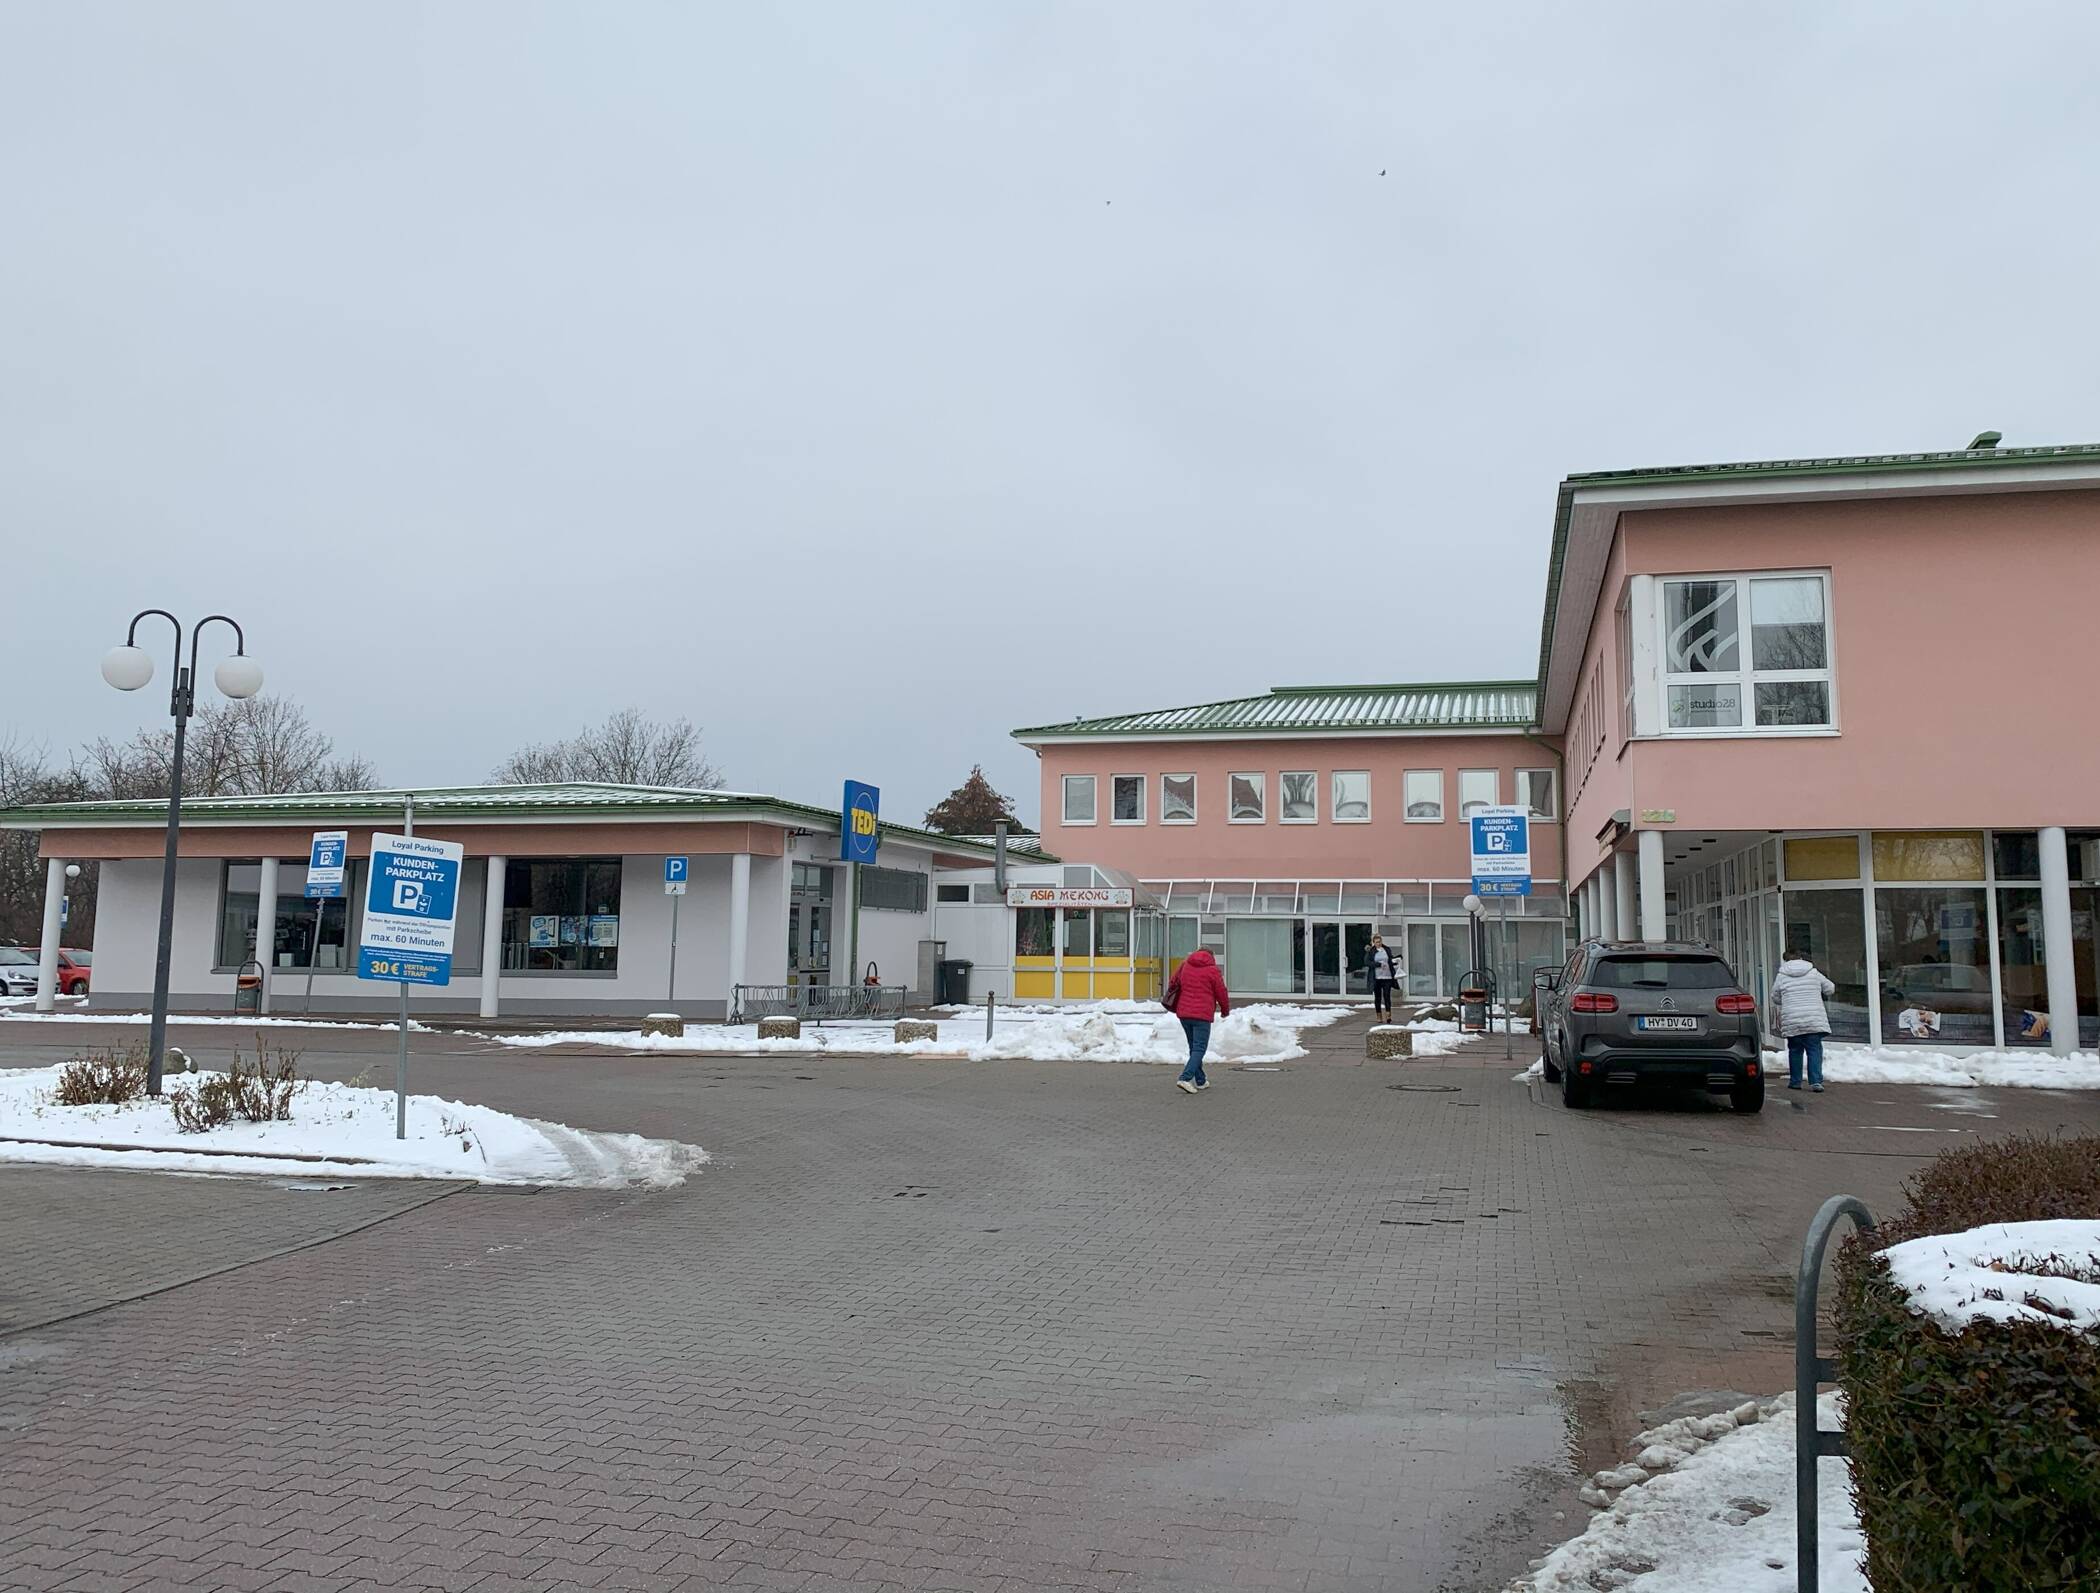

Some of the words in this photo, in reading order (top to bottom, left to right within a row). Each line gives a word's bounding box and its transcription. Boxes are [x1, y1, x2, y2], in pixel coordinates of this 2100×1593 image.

[851, 807, 877, 836] TEDi
[1480, 824, 1519, 832] PARKPLATZ
[392, 840, 413, 850] Loyal
[414, 843, 444, 855] Parking
[1492, 835, 1503, 848] P
[393, 856, 439, 870] KUNDEN-
[670, 860, 683, 879] P
[385, 866, 445, 882] PARKPLATZ
[400, 884, 418, 904] P
[1030, 889, 1055, 901] ASIA
[1060, 890, 1109, 901] MEKONG
[371, 933, 393, 943] max.
[395, 934, 407, 944] 60
[409, 936, 445, 948] Minuten
[370, 960, 389, 975] 30
[391, 962, 400, 976] €
[1648, 1018, 1660, 1027] HY
[1667, 1018, 1679, 1027] DV
[1681, 1018, 1693, 1027] 40
